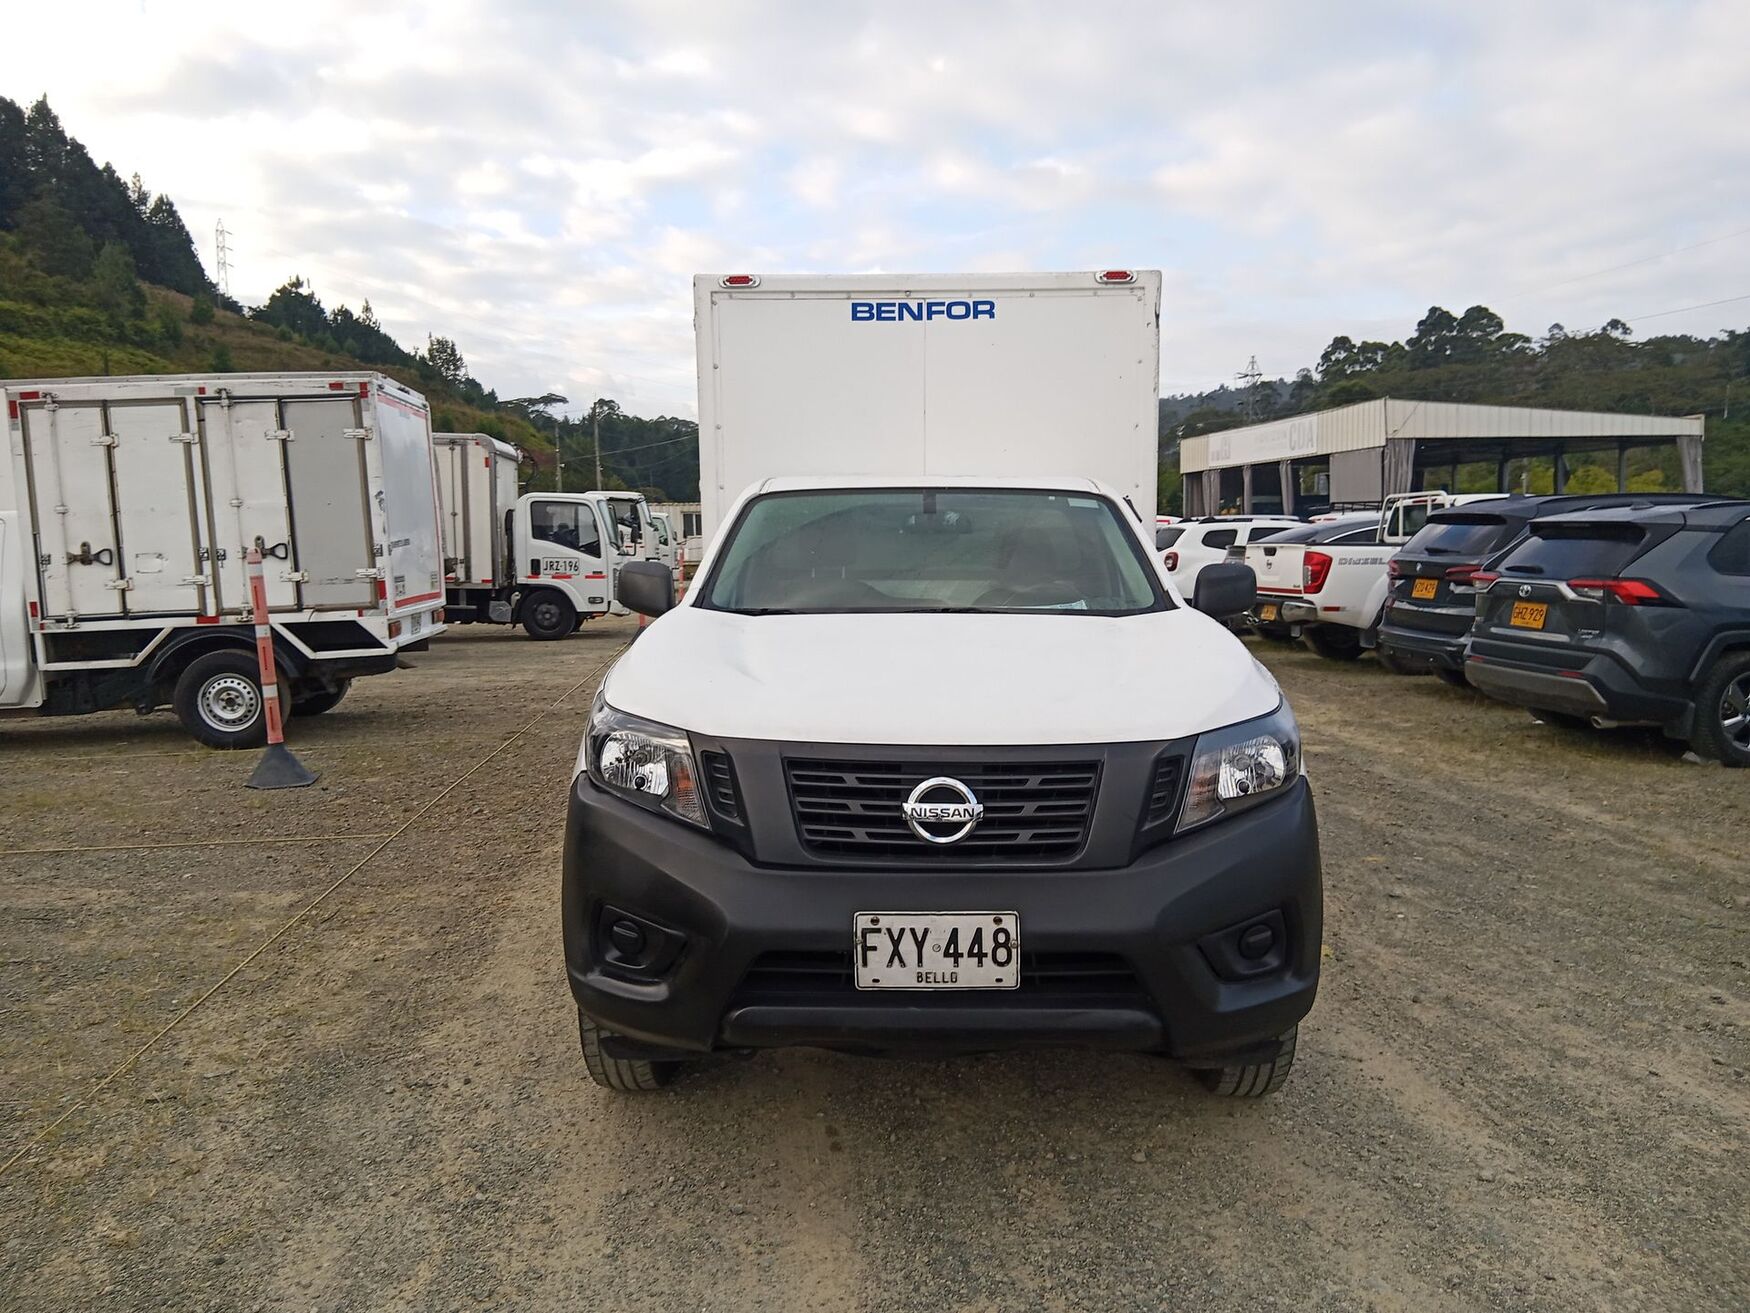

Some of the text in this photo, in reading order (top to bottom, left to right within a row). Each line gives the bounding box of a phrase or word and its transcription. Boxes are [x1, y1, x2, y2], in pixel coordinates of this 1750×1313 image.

[851, 300, 996, 322] BENFOR
[1288, 419, 1314, 451] CDA
[910, 806, 976, 819] NISSAN
[916, 971, 958, 984] BELLO
